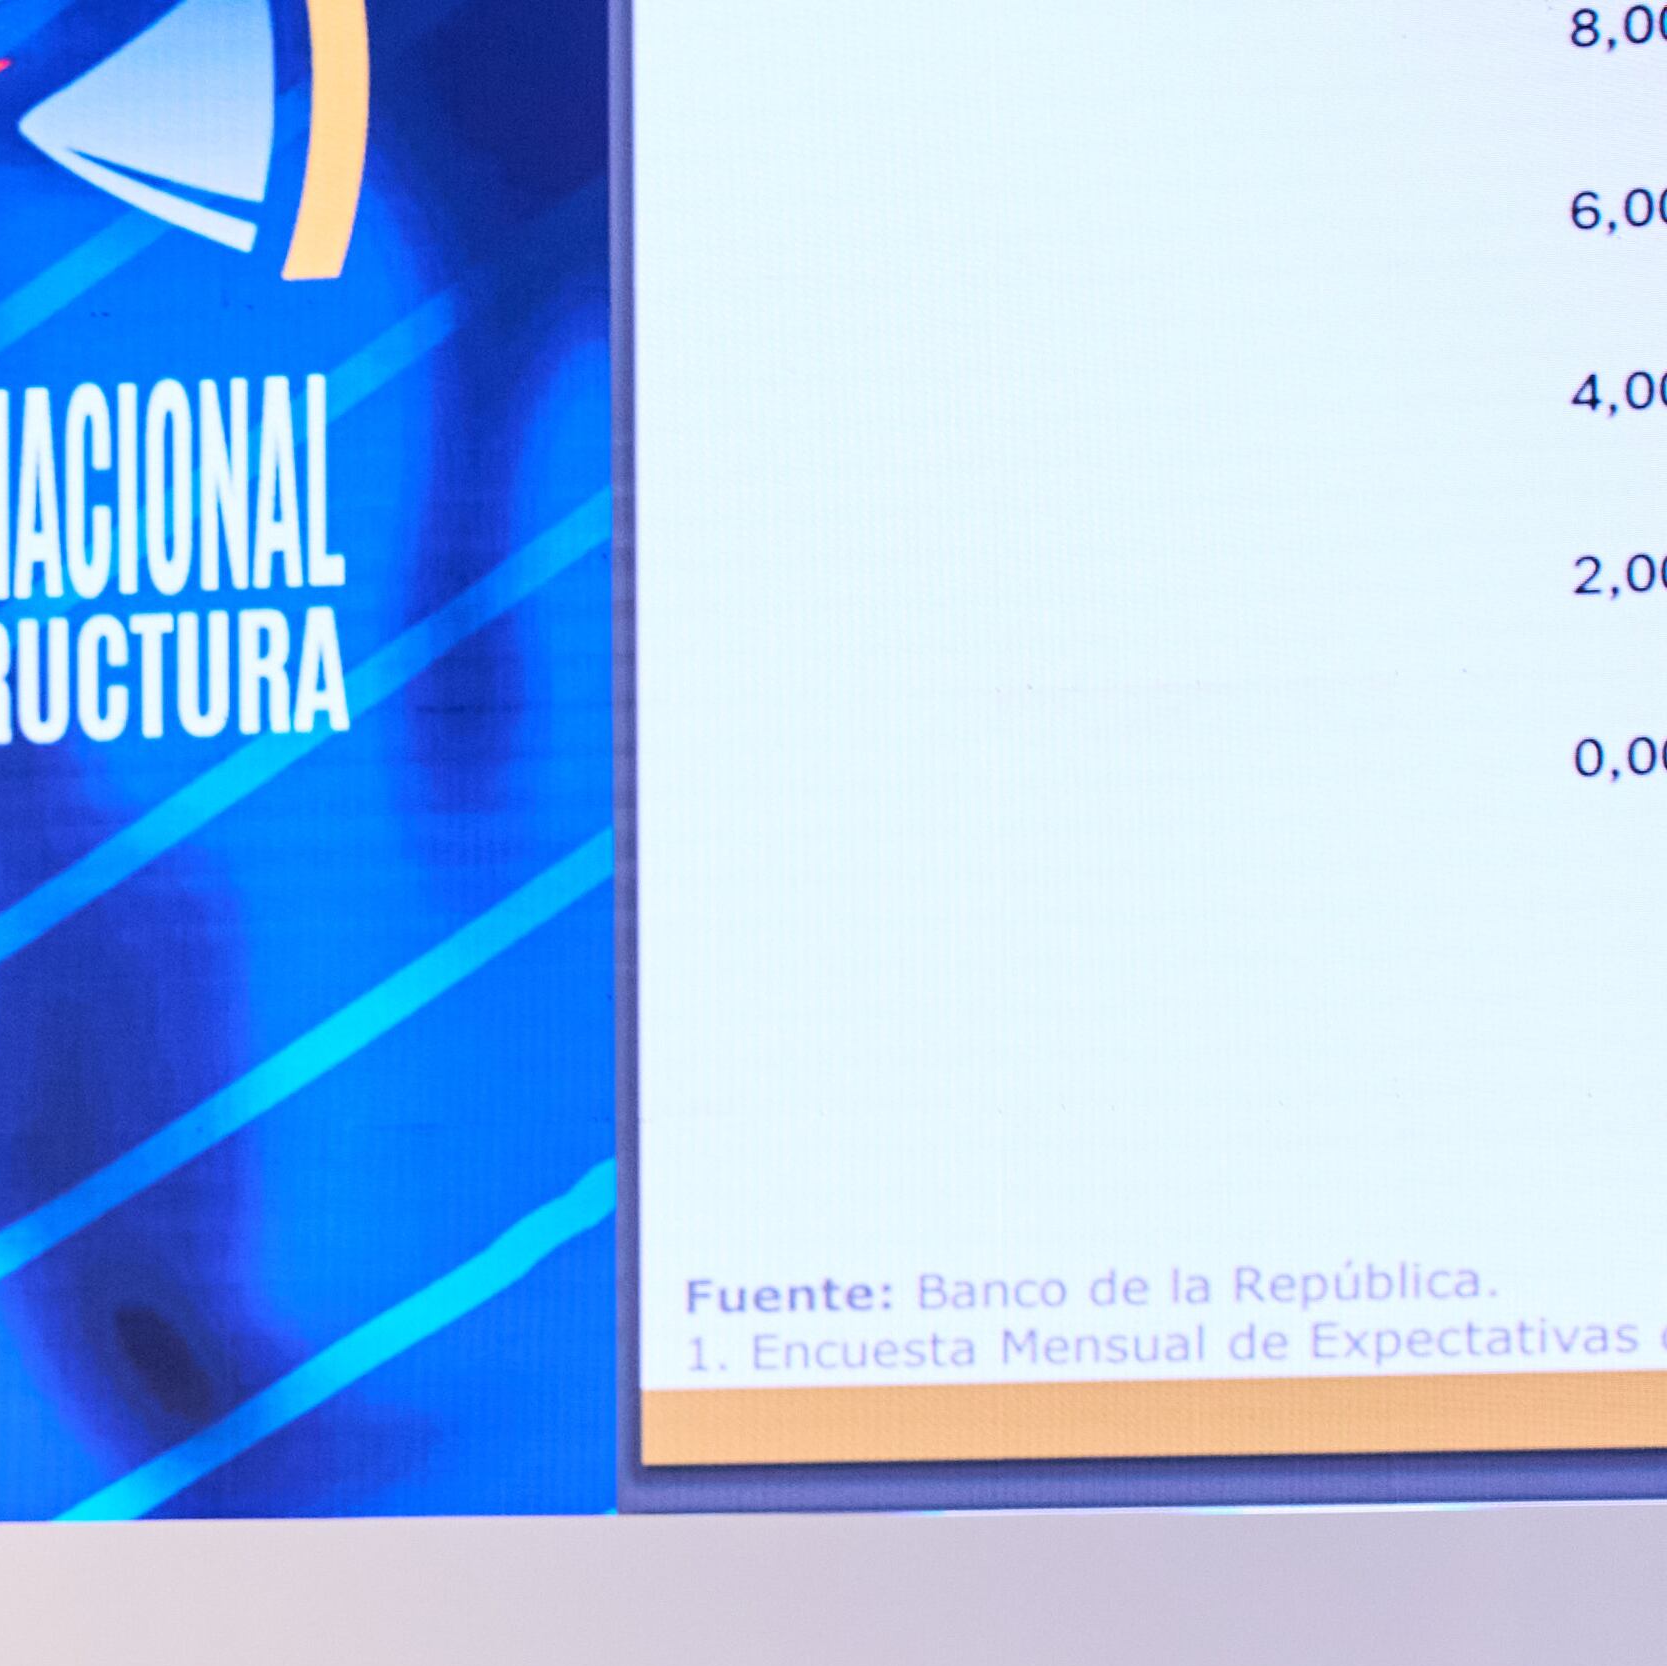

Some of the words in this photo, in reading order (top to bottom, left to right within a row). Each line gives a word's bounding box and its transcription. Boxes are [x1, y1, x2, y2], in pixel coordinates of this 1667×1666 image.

[1571, 5, 1667, 51] 8,0
[1571, 188, 1667, 236] 6,0
[1572, 371, 1667, 417] 4,0
[1574, 554, 1667, 600] 2,0
[1575, 736, 1667, 783] 0,0
[685, 1277, 893, 1314] Fuente:
[917, 1273, 1068, 1310] Banco
[1089, 1269, 1150, 1308] de
[1170, 1266, 1211, 1304] la
[1234, 1259, 1498, 1310] República.
[687, 1336, 727, 1372] 1.
[752, 1332, 977, 1371] Encuesta
[1002, 1323, 1206, 1367] Mensual
[1228, 1322, 1288, 1361] de
[1311, 1317, 1640, 1367] Expectativas
